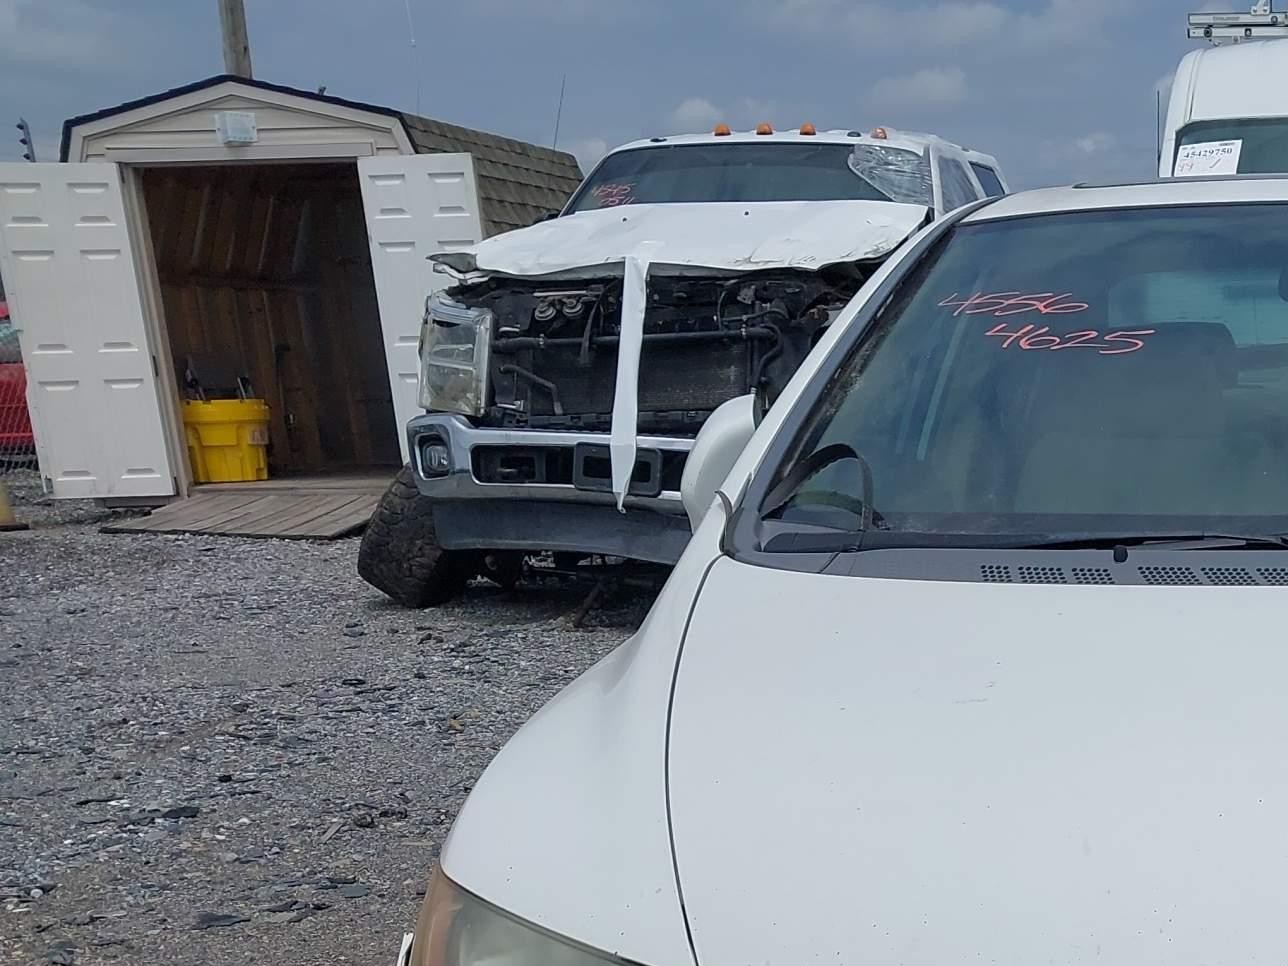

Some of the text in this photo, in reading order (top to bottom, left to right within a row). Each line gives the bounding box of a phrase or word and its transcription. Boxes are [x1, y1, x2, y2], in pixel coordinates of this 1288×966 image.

[1183, 147, 1233, 159] 45429750
[937, 291, 1090, 317] 4556
[984, 323, 1156, 356] 4625
